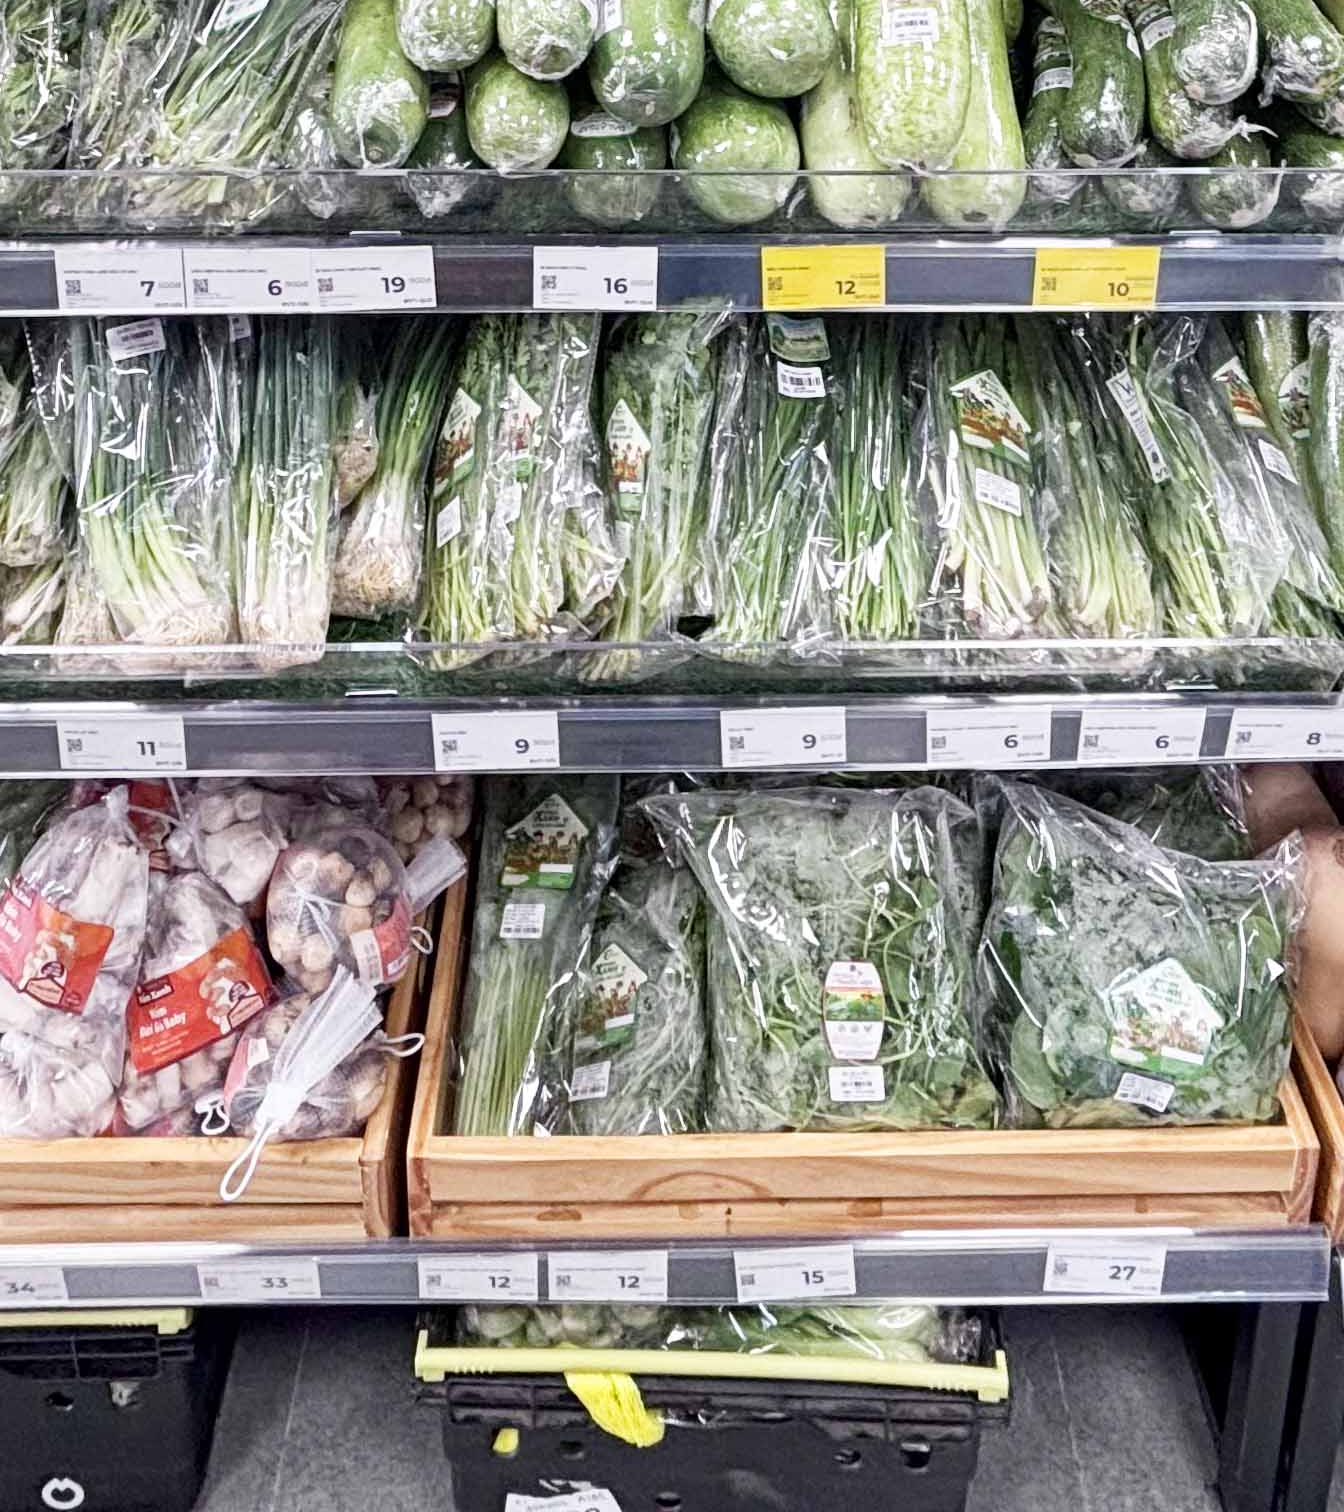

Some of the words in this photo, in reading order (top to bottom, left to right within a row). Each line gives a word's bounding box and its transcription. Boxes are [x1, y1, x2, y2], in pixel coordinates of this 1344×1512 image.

[140, 280, 155, 297] 7
[267, 279, 282, 296] 6
[381, 276, 406, 294] 19
[603, 277, 628, 294] 16
[835, 280, 856, 295] 12
[1108, 282, 1130, 297] 10
[514, 738, 530, 754] 9
[802, 734, 817, 749] 9
[1004, 734, 1019, 749] 6
[1155, 735, 1170, 749] 6
[1306, 732, 1322, 746] 8
[136, 741, 156, 756] 11
[801, 1270, 825, 1285] 15
[1109, 1265, 1137, 1281] 27
[488, 1276, 510, 1289] 12
[618, 1275, 640, 1289] 12
